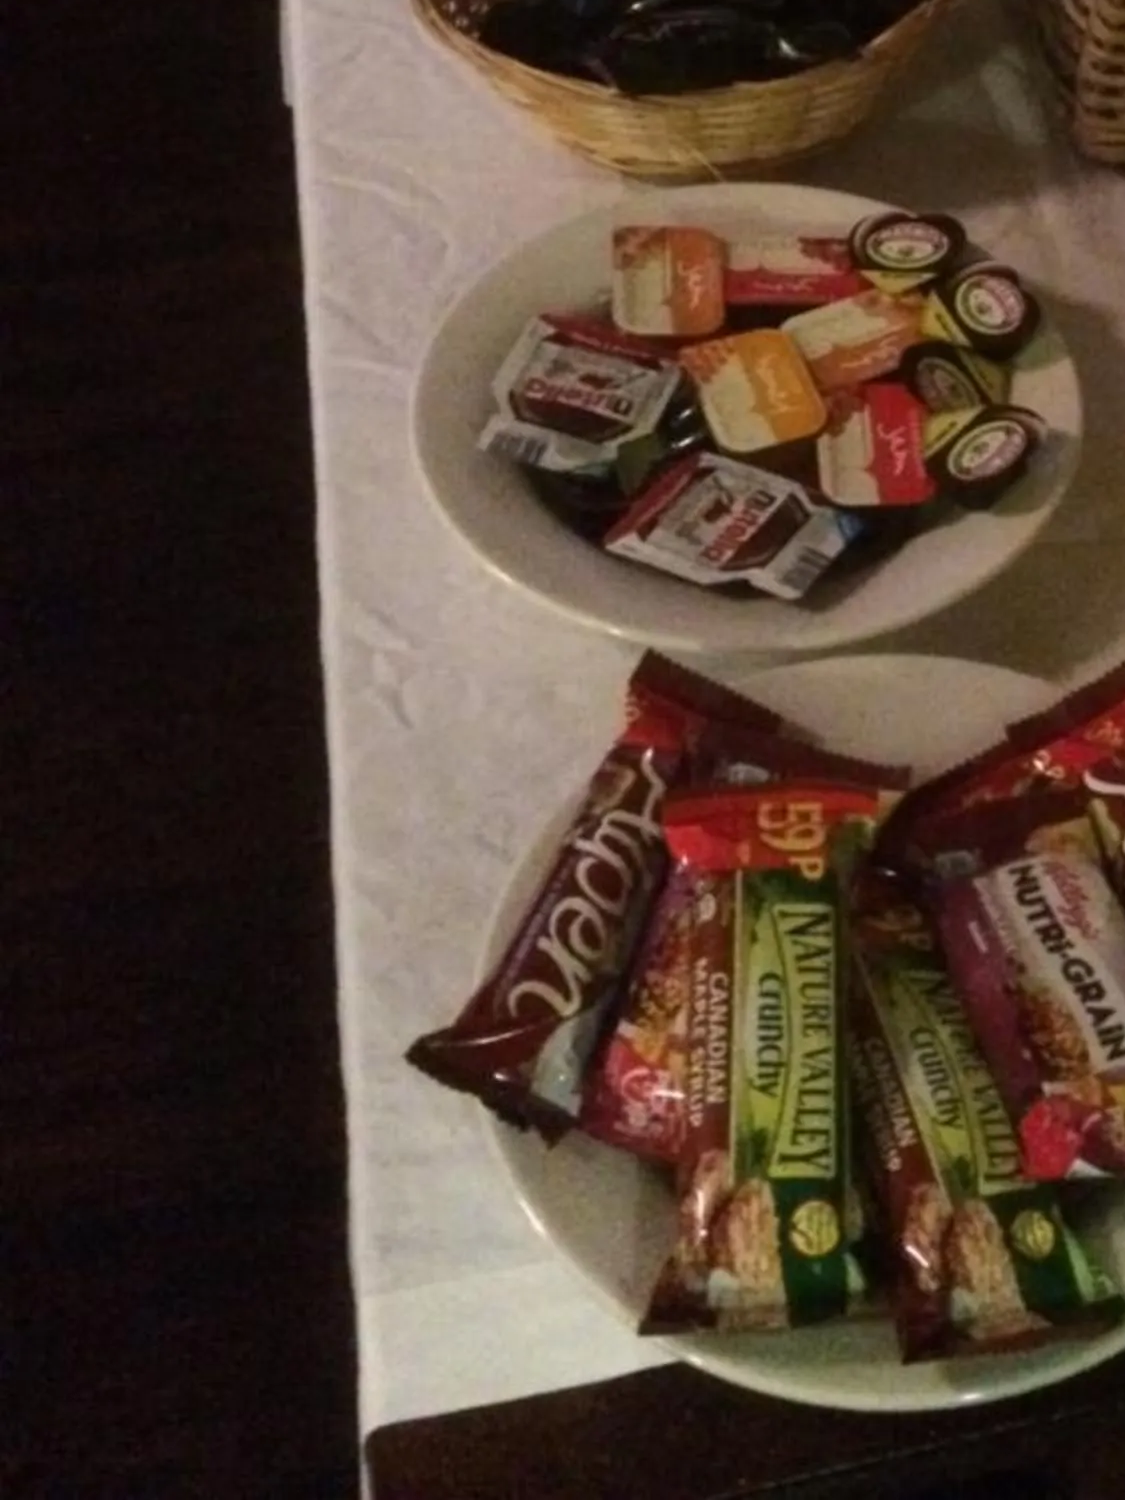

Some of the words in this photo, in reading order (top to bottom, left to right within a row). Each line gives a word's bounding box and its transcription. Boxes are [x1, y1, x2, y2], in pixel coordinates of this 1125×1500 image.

[706, 971, 729, 1105] CANADIAN
[777, 908, 832, 1040] NATURE
[777, 1045, 832, 1173] VALLEY
